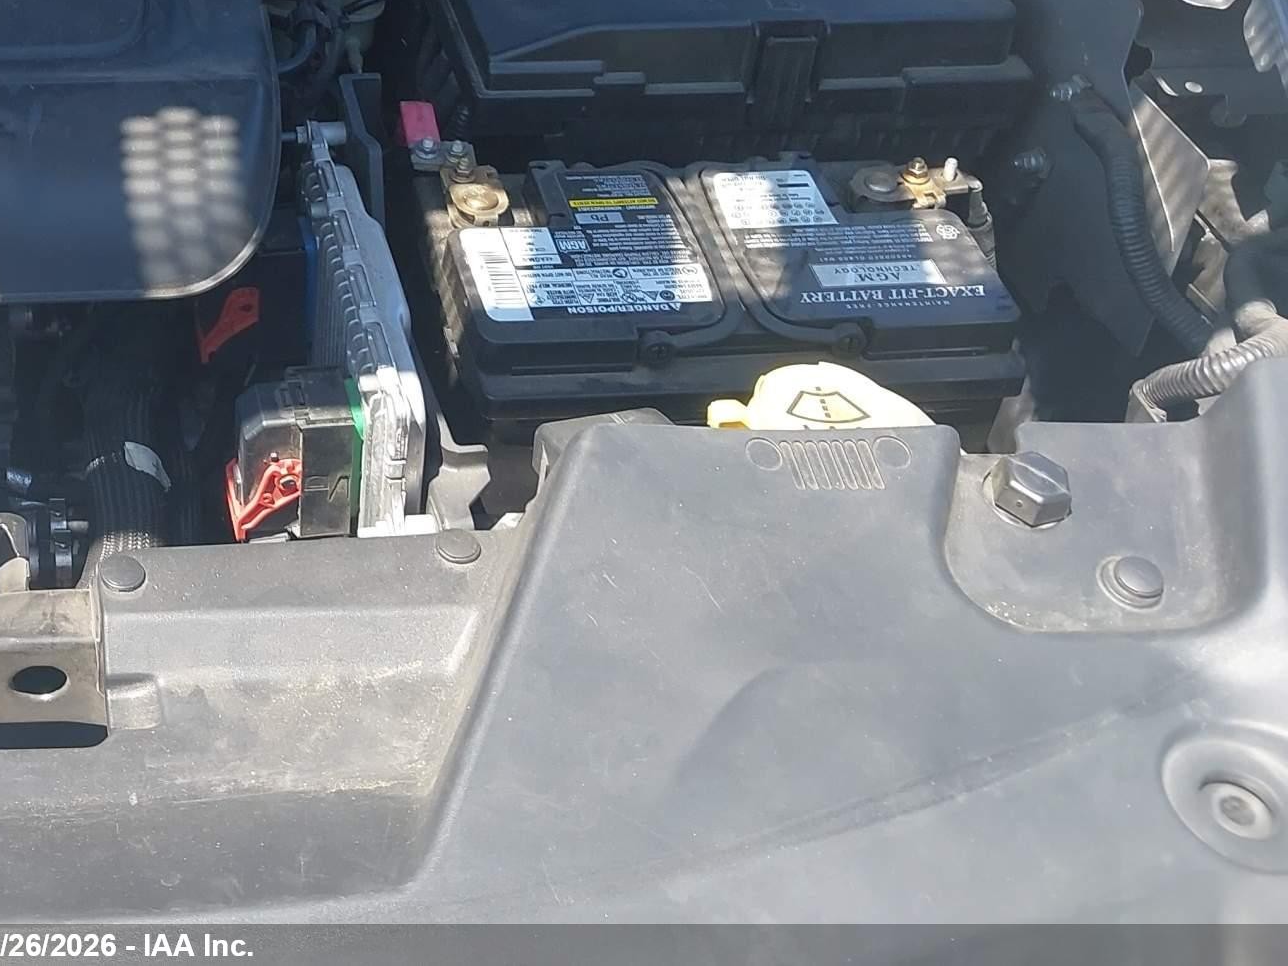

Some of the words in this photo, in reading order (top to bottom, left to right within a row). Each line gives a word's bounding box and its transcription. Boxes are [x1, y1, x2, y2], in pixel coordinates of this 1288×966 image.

[590, 213, 609, 221] Pb
[558, 240, 587, 251] AGM
[834, 265, 917, 274] TECHNOLOGY
[800, 289, 884, 304] BATTERY
[888, 284, 986, 300] EXACT-FIT
[567, 303, 670, 314] DANGER/POISON
